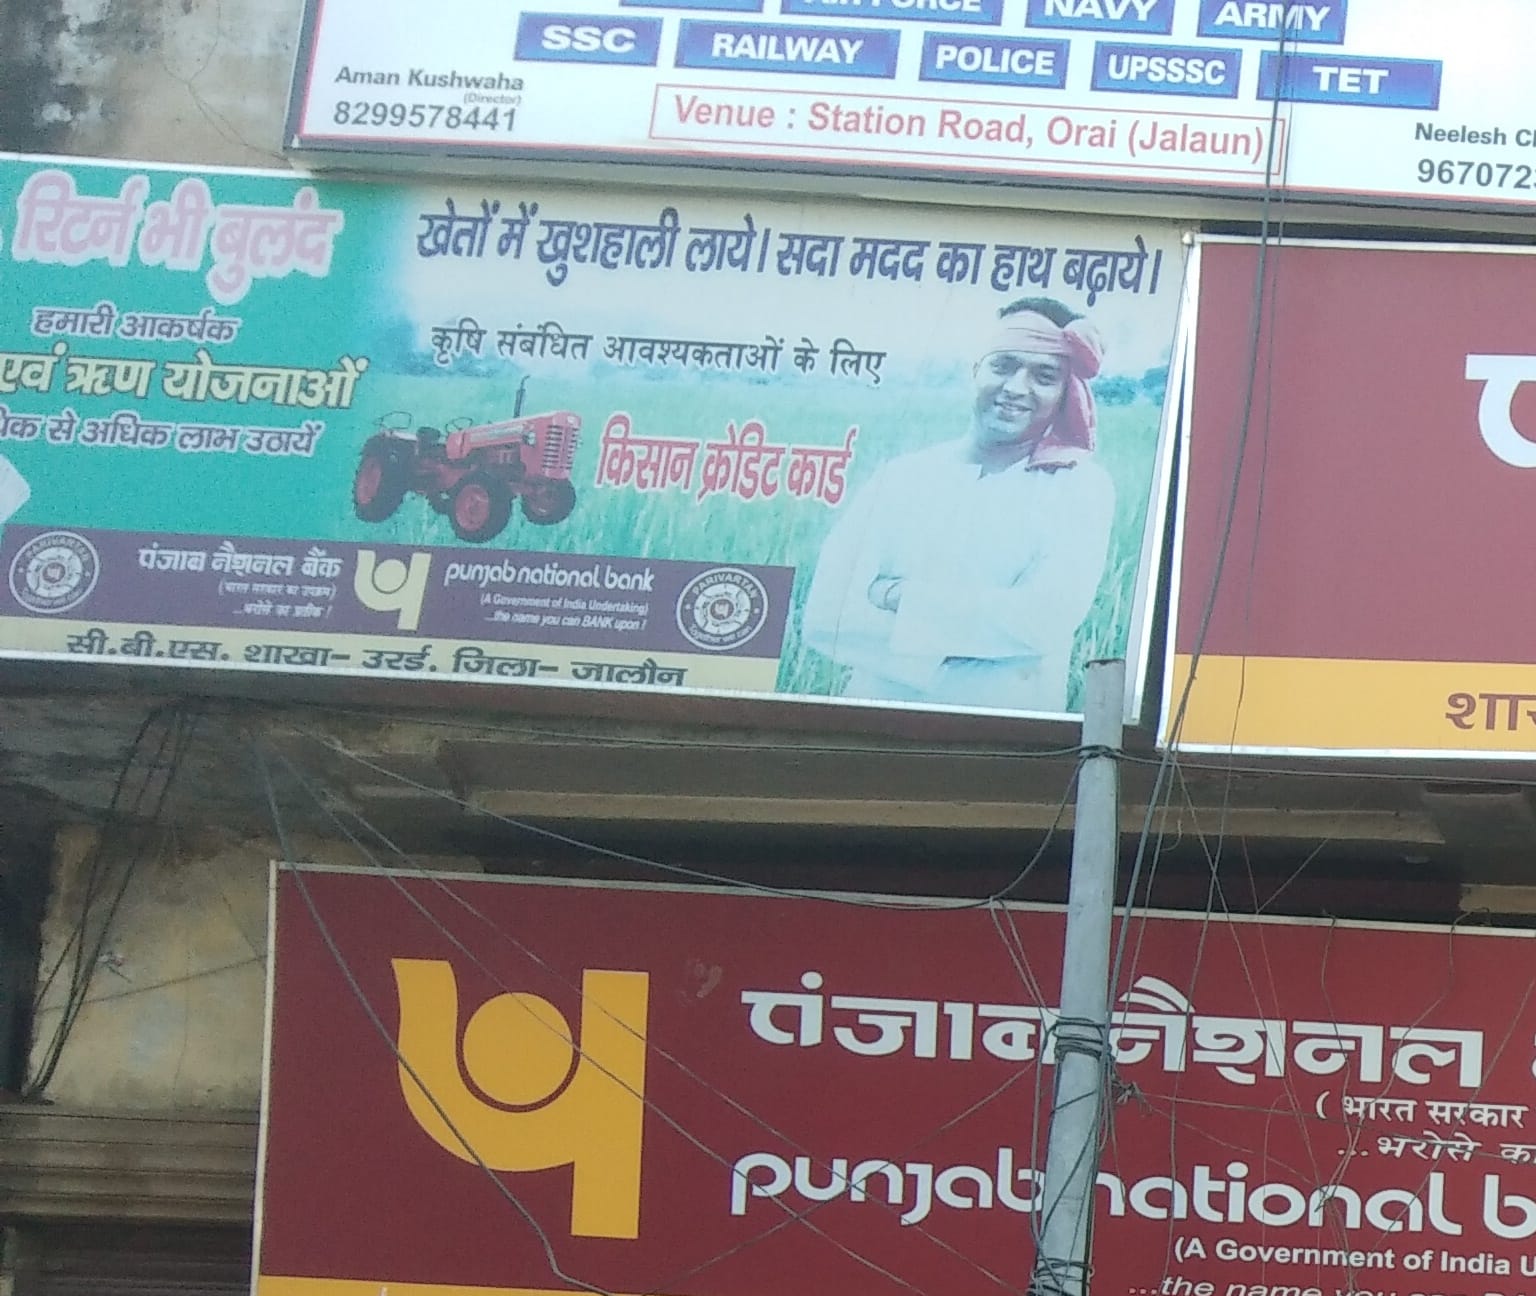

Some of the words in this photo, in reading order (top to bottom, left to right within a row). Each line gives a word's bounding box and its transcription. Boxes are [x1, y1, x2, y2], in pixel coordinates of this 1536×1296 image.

[1214, 1, 1330, 31] ARMY
[334, 66, 400, 86] Aman
[408, 69, 523, 91] Kushwaha
[542, 24, 636, 54] SSC
[712, 33, 864, 64] RAILWAY
[936, 45, 1054, 75] POLICE
[1108, 54, 1225, 85] UPSSSC
[1312, 65, 1389, 95] TET
[333, 101, 516, 131] 8299578441
[463, 91, 521, 106] (Director)
[675, 95, 775, 128] Venue
[808, 102, 925, 136] Station
[938, 109, 1033, 149] Road,
[1047, 116, 1115, 149] Orai
[1128, 120, 1264, 163] (Jalaun)
[1415, 122, 1506, 147] Neelesh
[14, 171, 149, 266] रिटर्न
[140, 178, 212, 270] भी
[207, 187, 344, 304] बुलंद
[416, 198, 500, 258] खेतों
[498, 201, 538, 259] में
[537, 207, 681, 287] खुशहाली
[776, 232, 844, 278] सदा
[850, 237, 931, 281] मदद
[936, 242, 986, 285] का
[990, 244, 1057, 291] हाथ
[32, 301, 115, 337] हमारी
[119, 306, 241, 342] आकर्षक
[431, 317, 487, 364] कृषि
[603, 335, 783, 371] आवश्यकताओं
[793, 338, 819, 373] के
[830, 338, 887, 385] लिए
[65, 357, 156, 398] ऋण
[163, 348, 370, 409] योजनाओं
[46, 409, 73, 442] से
[80, 410, 168, 449] अधिक
[177, 423, 240, 451] लाभ
[242, 421, 323, 456] उठायें
[595, 414, 700, 492] किसान
[697, 423, 786, 503] क्रेडिट
[787, 425, 858, 505] कार्ड
[138, 542, 206, 571] पंजाब
[211, 541, 295, 576] नैशनल
[301, 547, 344, 578] बैंक
[444, 559, 516, 587] punjab
[517, 562, 600, 587] national
[605, 565, 655, 592] bank
[692, 573, 759, 598] PARIVARTAN
[570, 658, 688, 687] जालौन
[741, 971, 1058, 1066] पंजाब
[1107, 975, 1484, 1088] नैशनल
[1427, 1101, 1524, 1131] सरकार
[731, 1147, 1043, 1226] punjab
[1095, 1162, 1463, 1236] national
[1174, 1237, 1206, 1263] (A
[1215, 1239, 1395, 1269] Government
[1403, 1250, 1433, 1271] of
[1441, 1250, 1510, 1277] India
